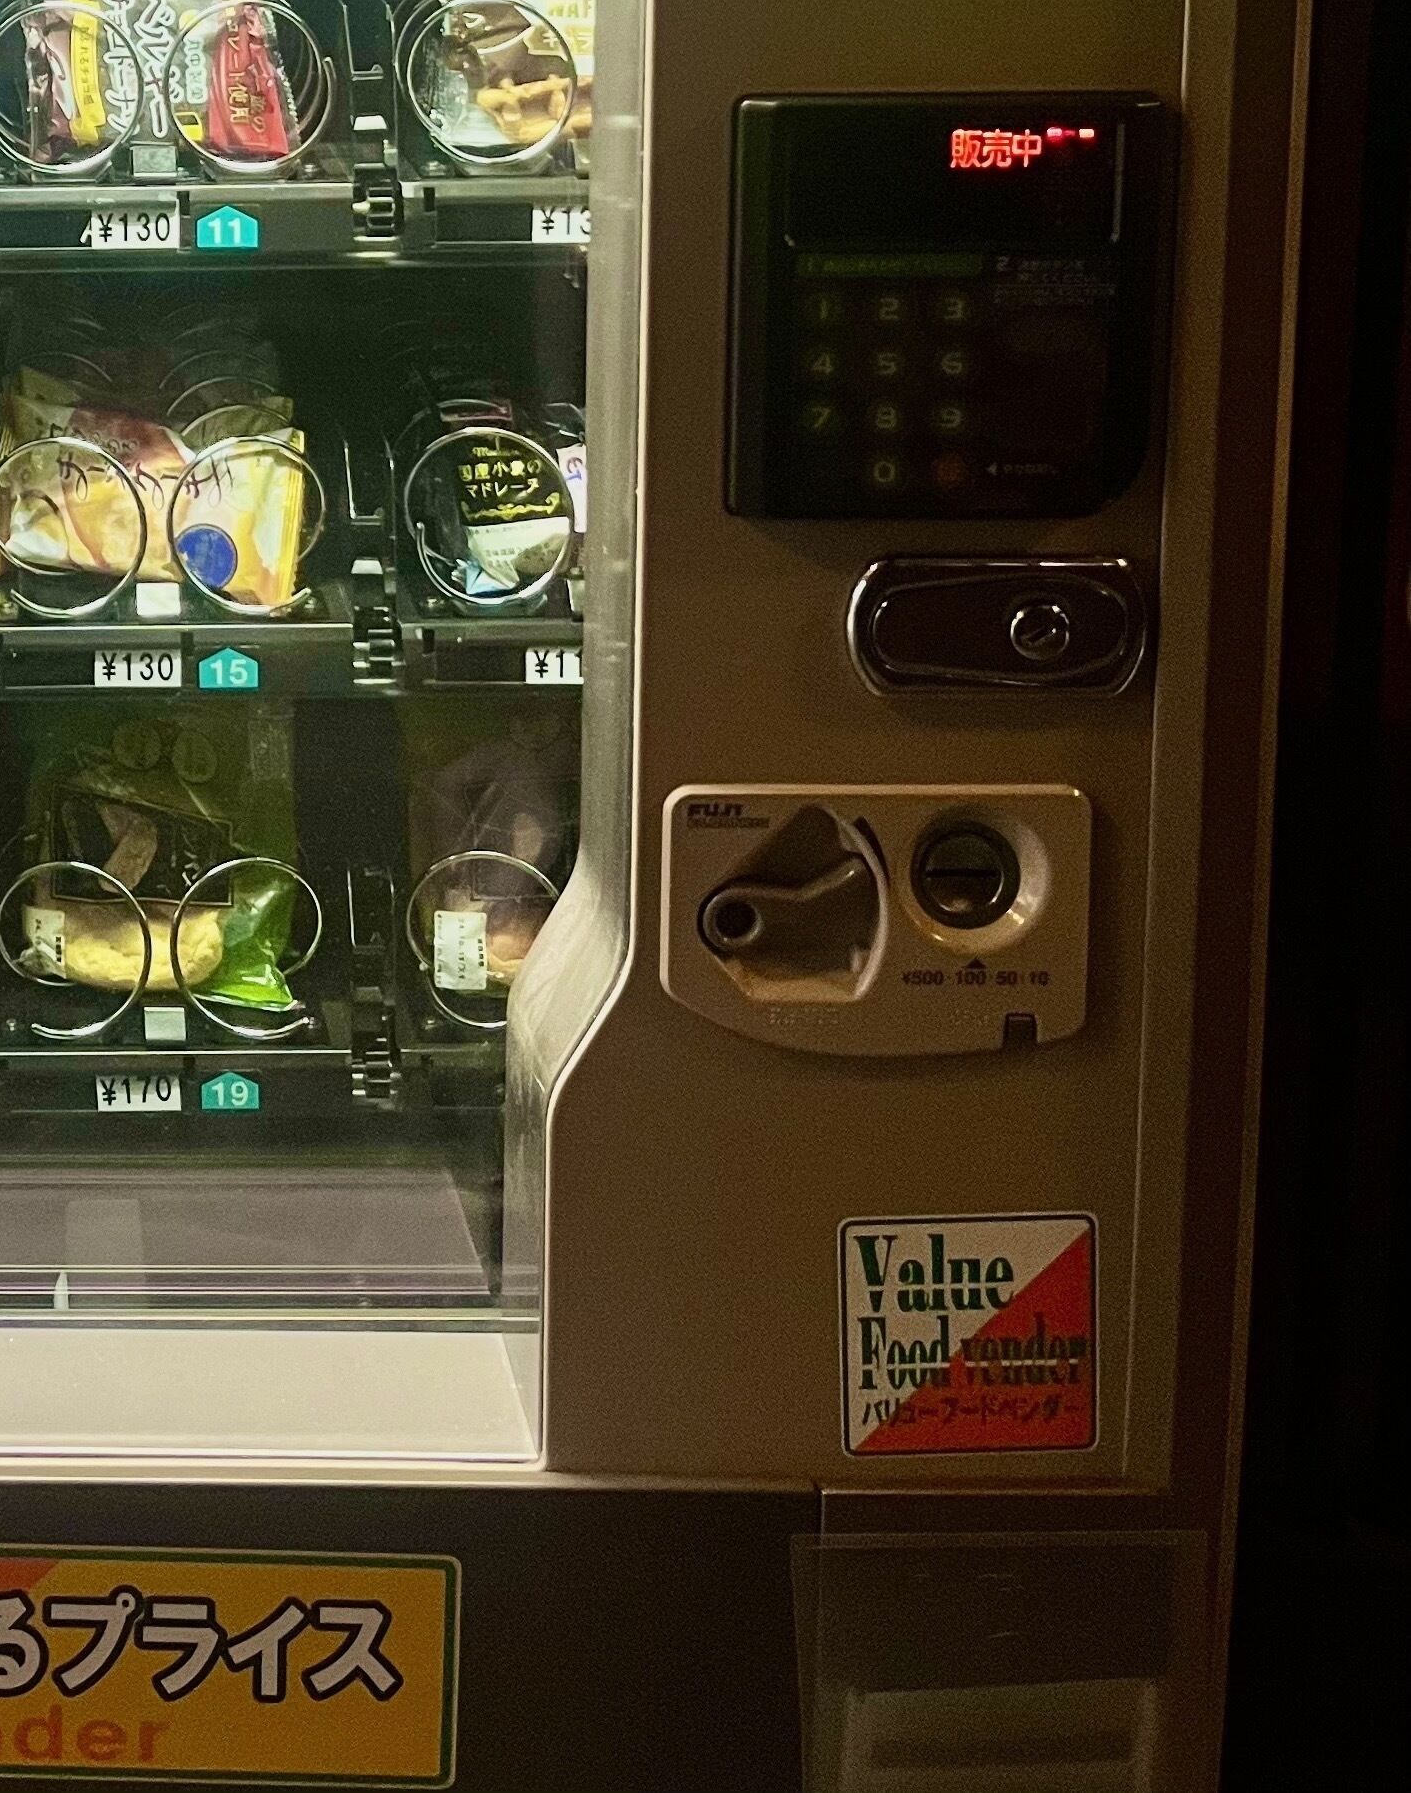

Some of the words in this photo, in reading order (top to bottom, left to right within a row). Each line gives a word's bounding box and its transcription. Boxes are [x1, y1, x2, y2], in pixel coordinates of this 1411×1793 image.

[950, 128, 1042, 169] 販売中
[97, 212, 170, 242] ¥130
[207, 219, 243, 245] 11
[101, 652, 174, 682] ¥130
[210, 659, 249, 685] 15
[100, 1076, 172, 1107] ¥170
[211, 1080, 249, 1107] 19
[853, 1233, 1015, 1312] Value
[856, 1314, 951, 1390] Food
